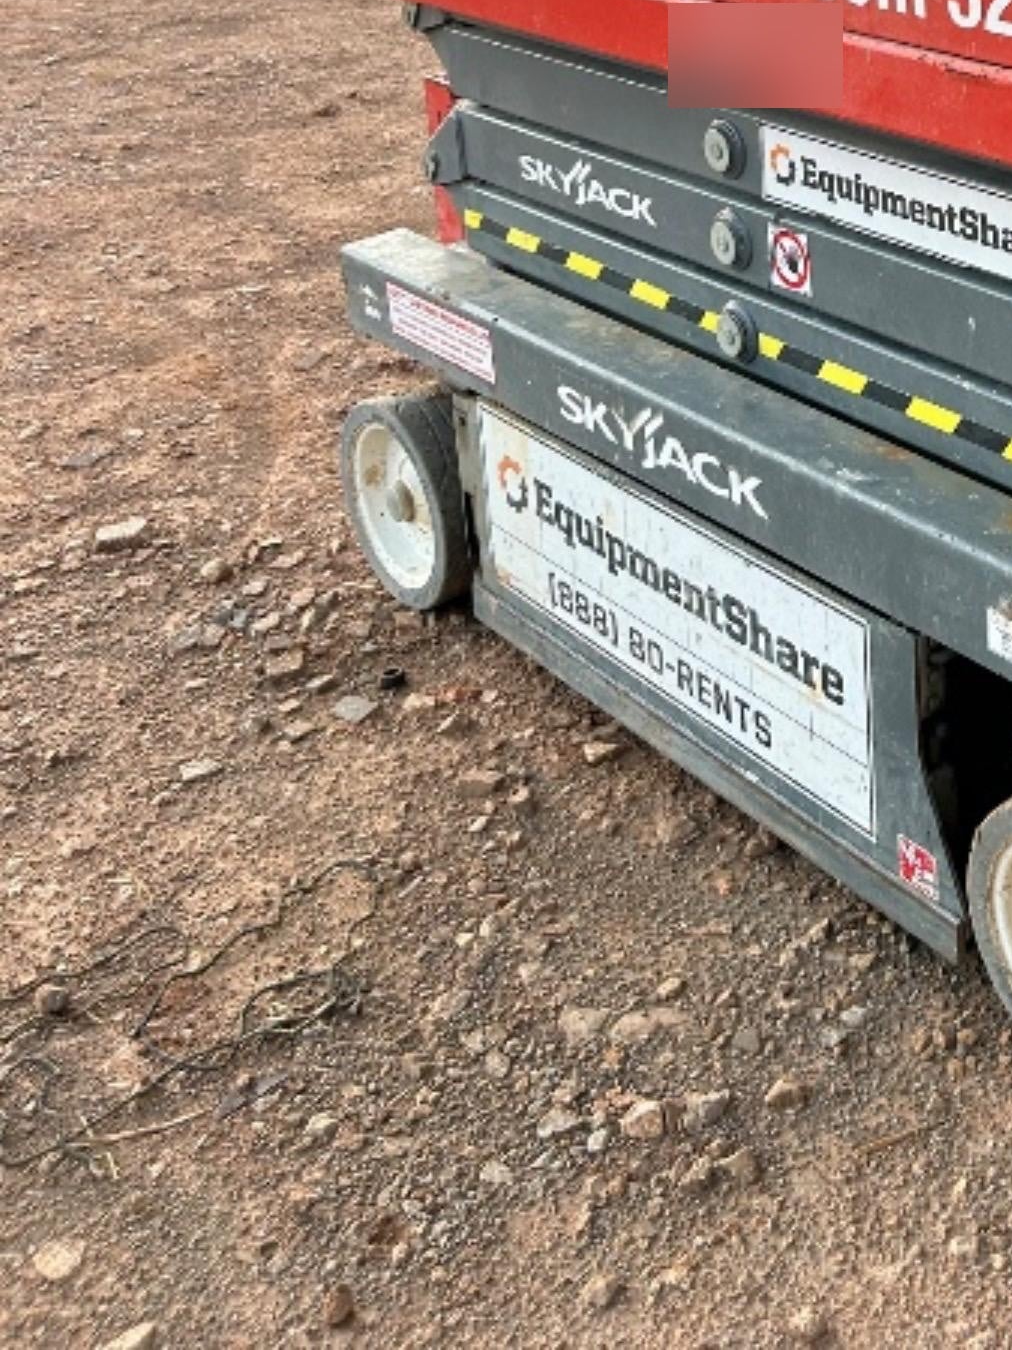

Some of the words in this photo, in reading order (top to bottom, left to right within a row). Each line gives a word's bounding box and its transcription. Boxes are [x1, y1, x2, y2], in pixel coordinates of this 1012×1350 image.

[519, 154, 658, 228] SKYJACK
[557, 385, 770, 521] SKYJACK
[533, 479, 845, 707] EquipmentShare
[548, 571, 619, 644] (888)
[629, 625, 773, 750] 80-RENTS
